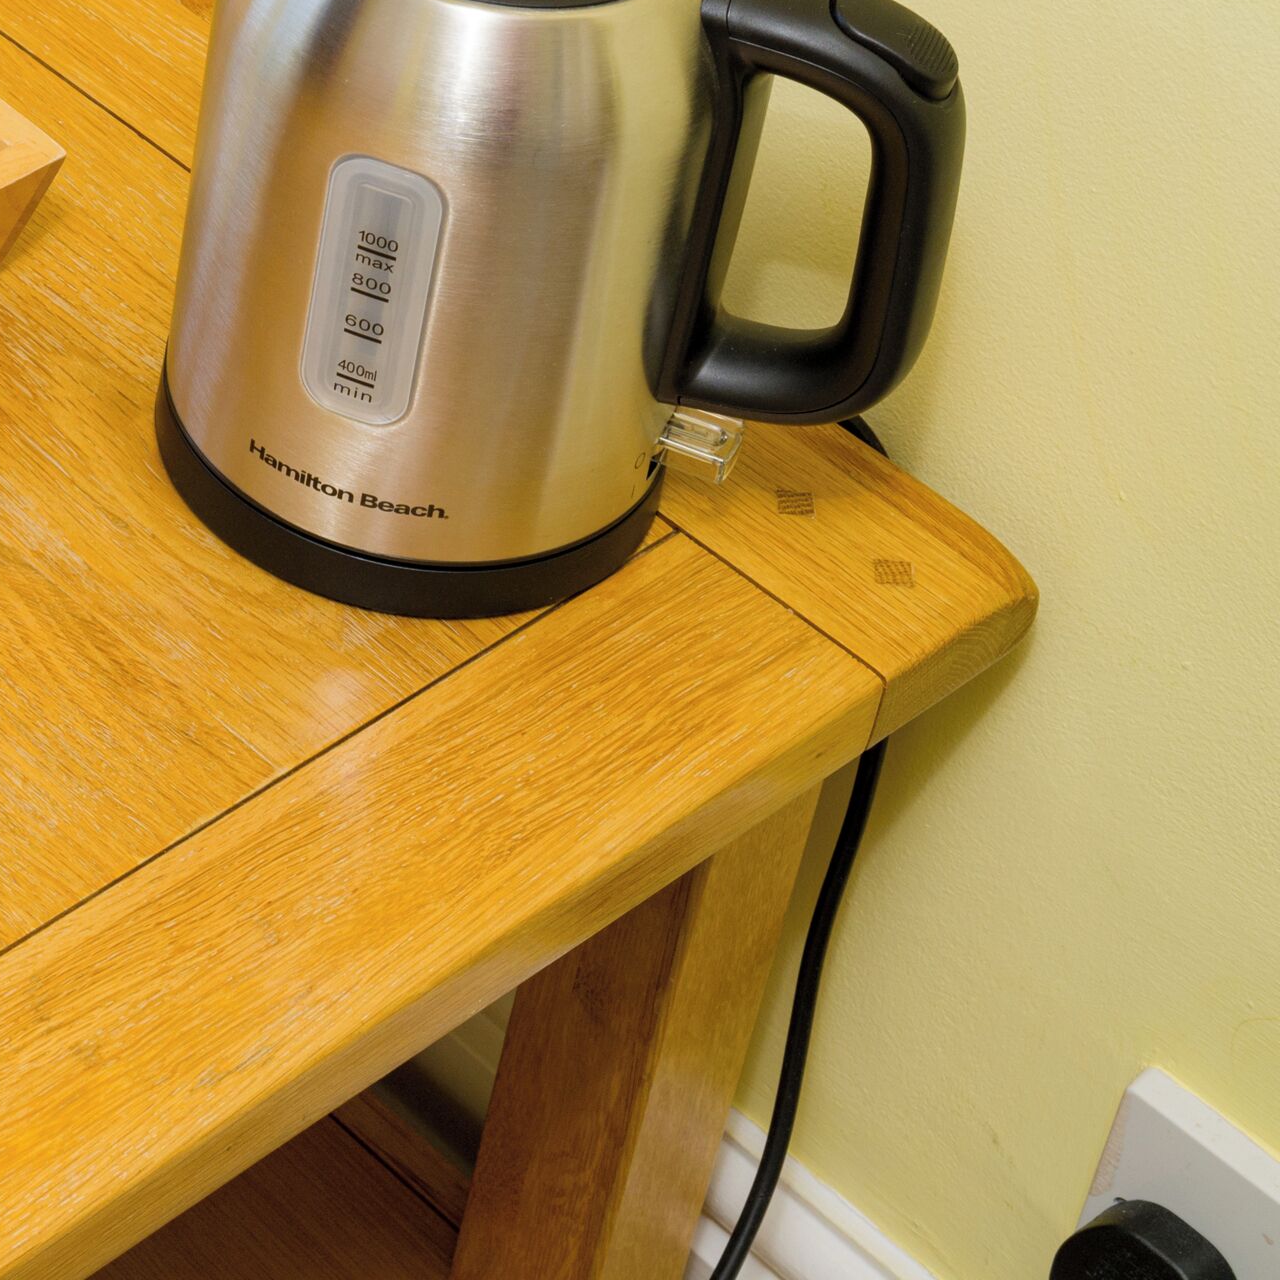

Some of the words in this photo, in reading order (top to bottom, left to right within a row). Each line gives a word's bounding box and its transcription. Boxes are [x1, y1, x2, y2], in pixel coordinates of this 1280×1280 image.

[359, 230, 399, 252] 1000
[355, 253, 394, 274] max
[352, 272, 392, 295] 800
[345, 314, 384, 336] 600
[337, 360, 378, 382] 400ml
[333, 382, 373, 403] min
[249, 438, 354, 504] Hamilton
